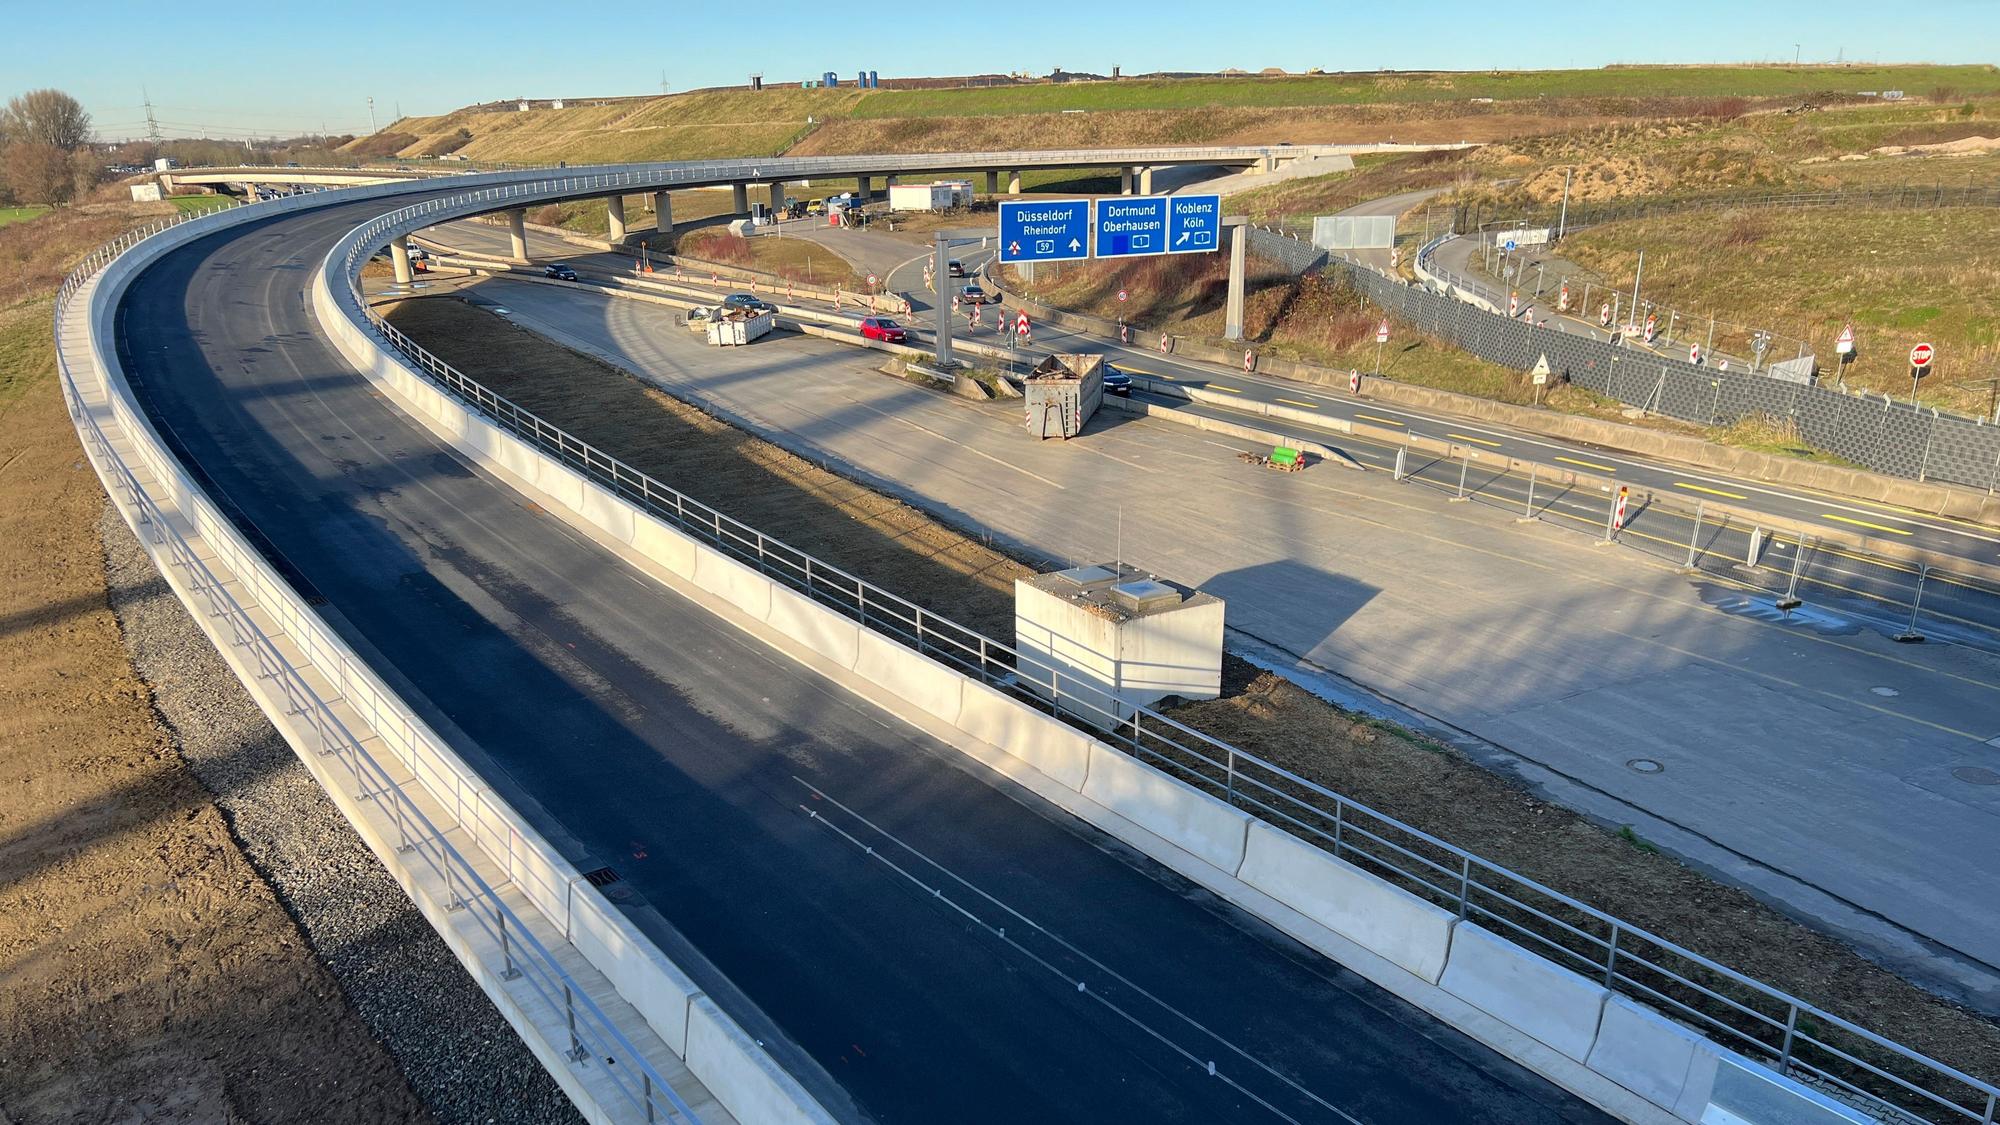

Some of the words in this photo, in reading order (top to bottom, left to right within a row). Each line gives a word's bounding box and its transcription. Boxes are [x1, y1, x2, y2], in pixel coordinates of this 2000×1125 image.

[1108, 204, 1156, 217] Dortmund
[1176, 202, 1212, 214] Koblenz
[1017, 209, 1072, 222] Düsseldorf
[1104, 220, 1160, 232] Oberhausen
[1184, 217, 1204, 228] Köln
[1024, 224, 1066, 235] Rheindorf
[1912, 350, 1930, 360] STOP
